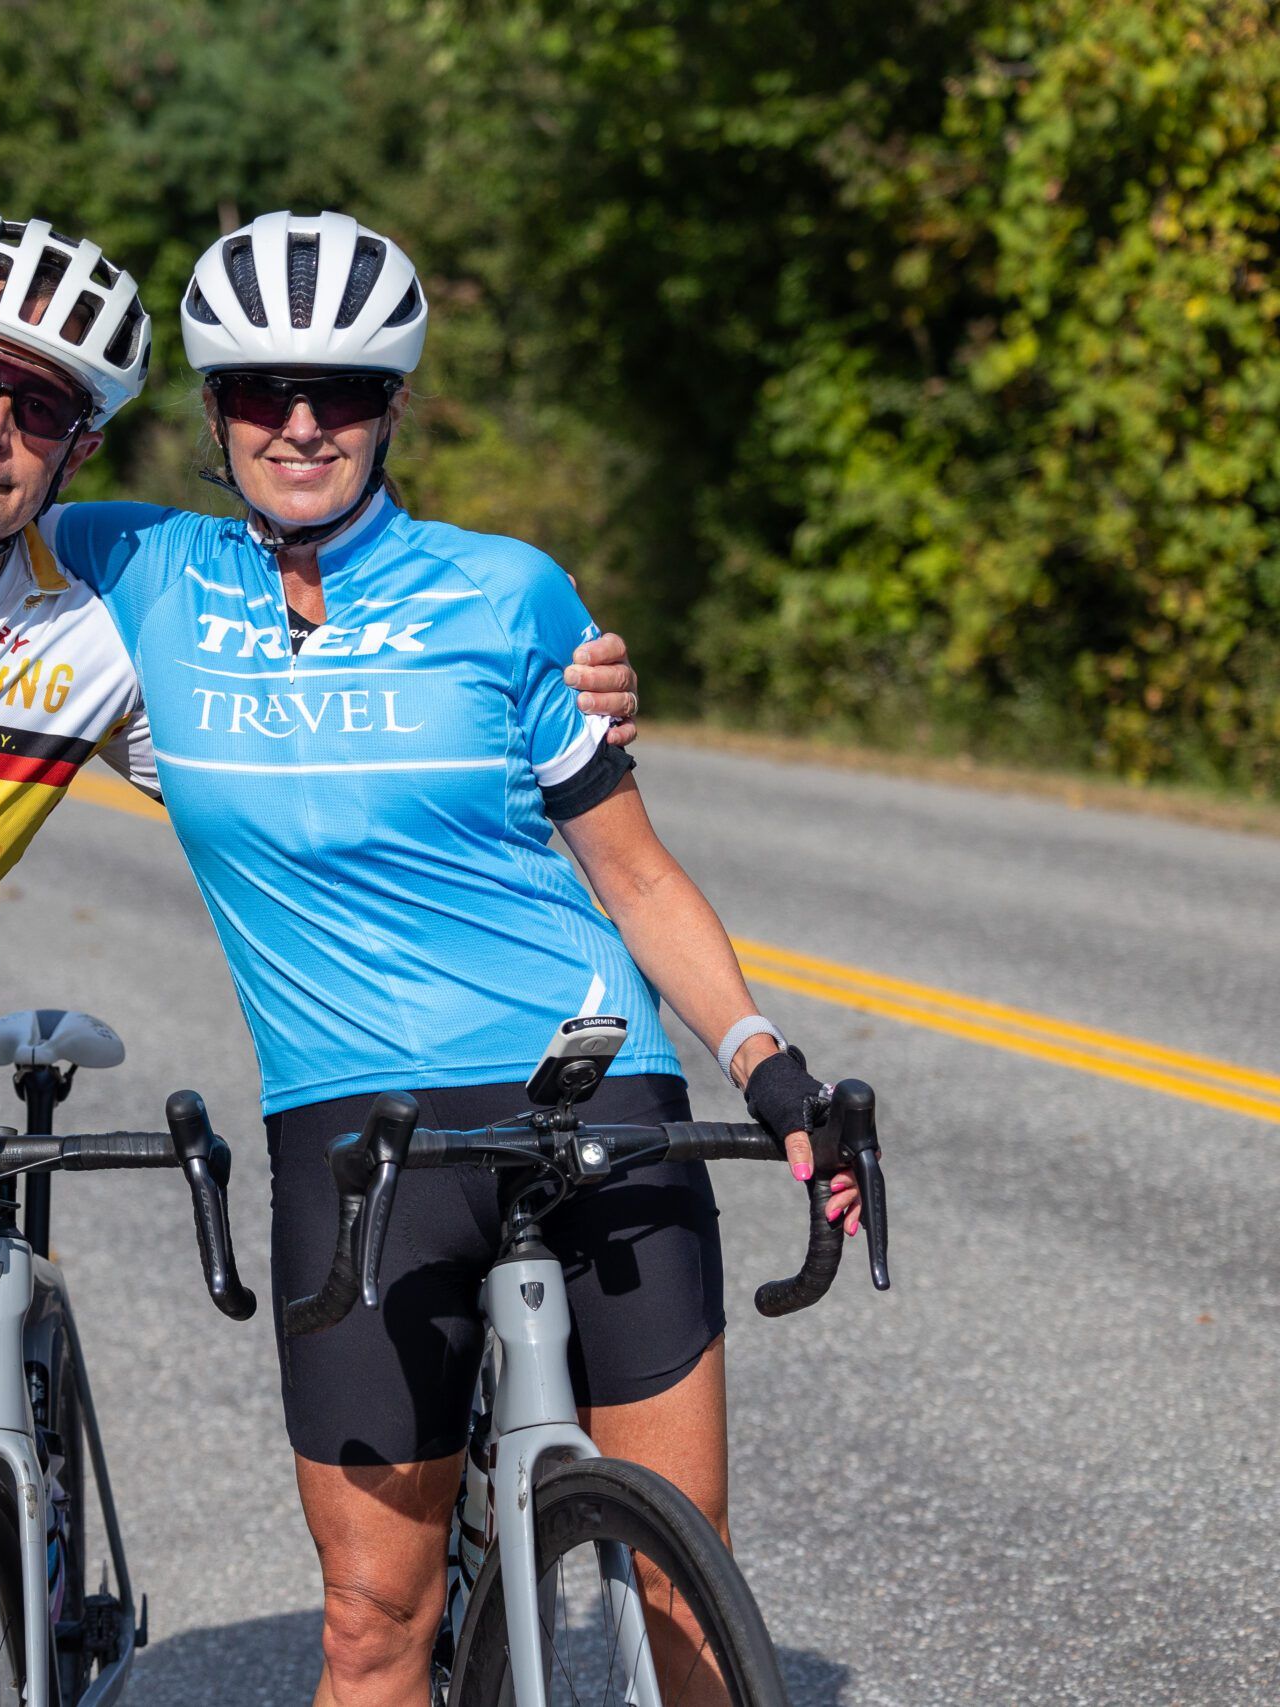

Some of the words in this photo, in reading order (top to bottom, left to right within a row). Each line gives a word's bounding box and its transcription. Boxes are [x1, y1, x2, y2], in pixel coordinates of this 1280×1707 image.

[197, 614, 434, 660] TREK
[191, 687, 426, 739] TRAVEL
[582, 1018, 617, 1026] GARMIN
